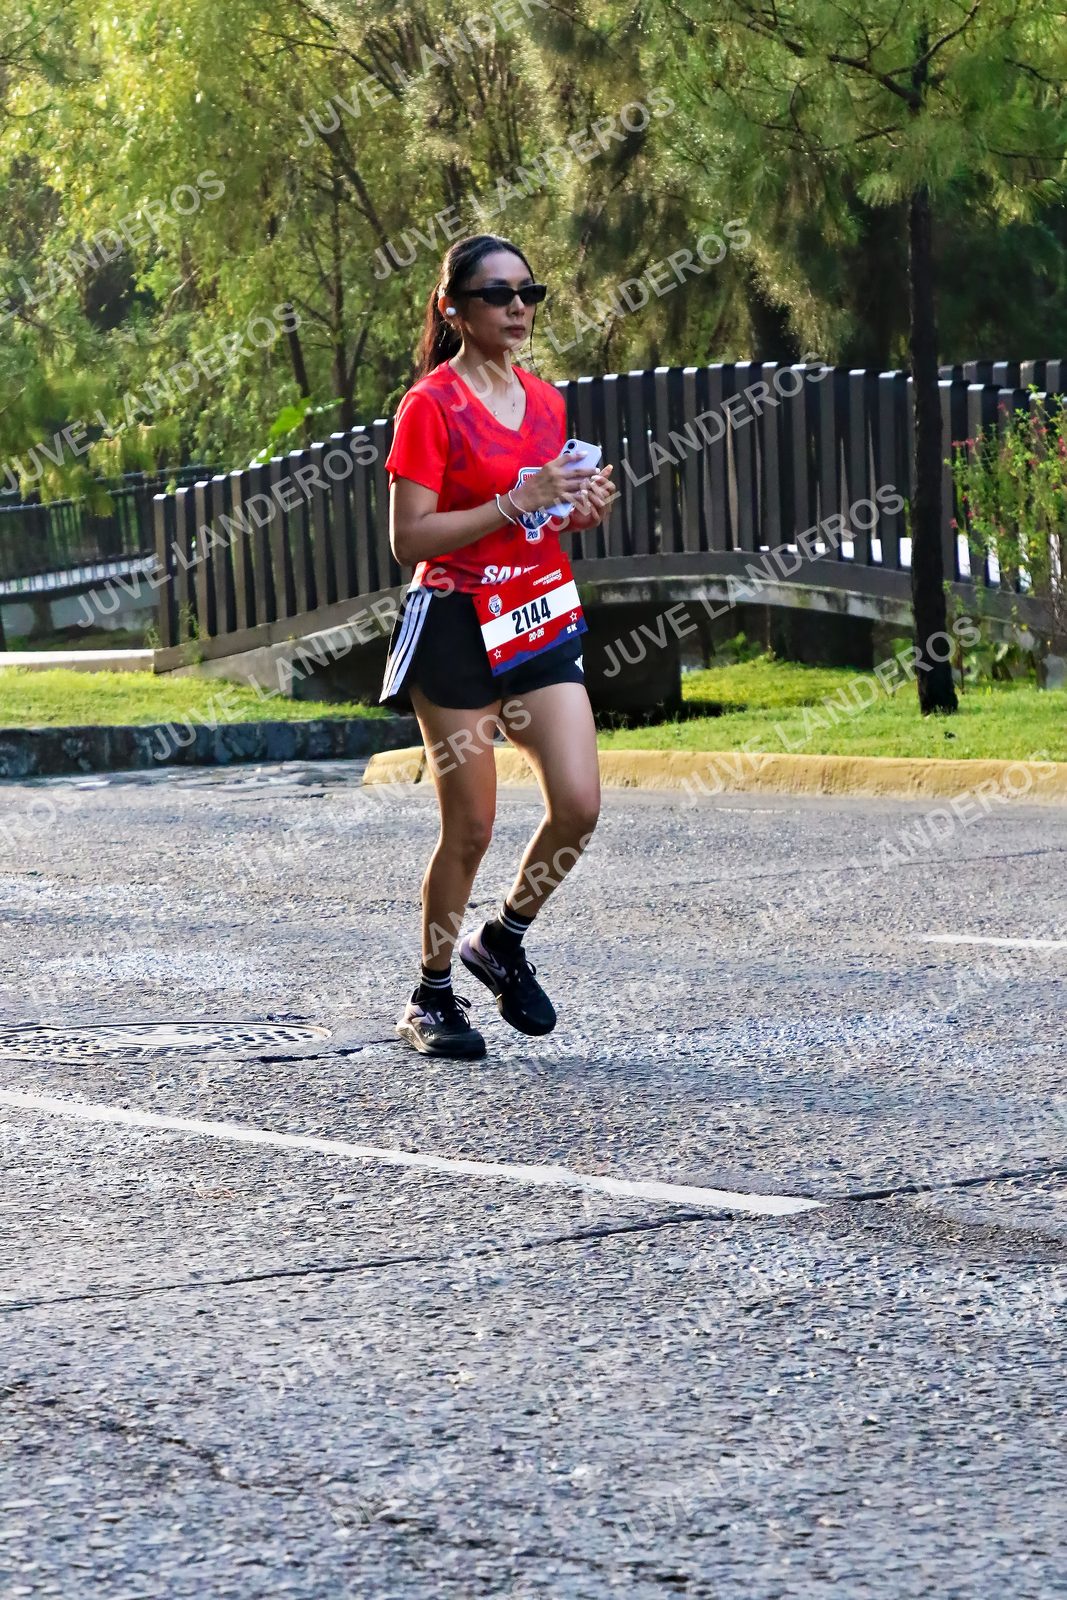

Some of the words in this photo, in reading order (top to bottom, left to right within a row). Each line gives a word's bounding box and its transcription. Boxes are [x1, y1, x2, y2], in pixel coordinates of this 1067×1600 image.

[512, 597, 552, 635] 2144
[528, 627, 545, 642] 20-26
[566, 624, 578, 634] 5K
